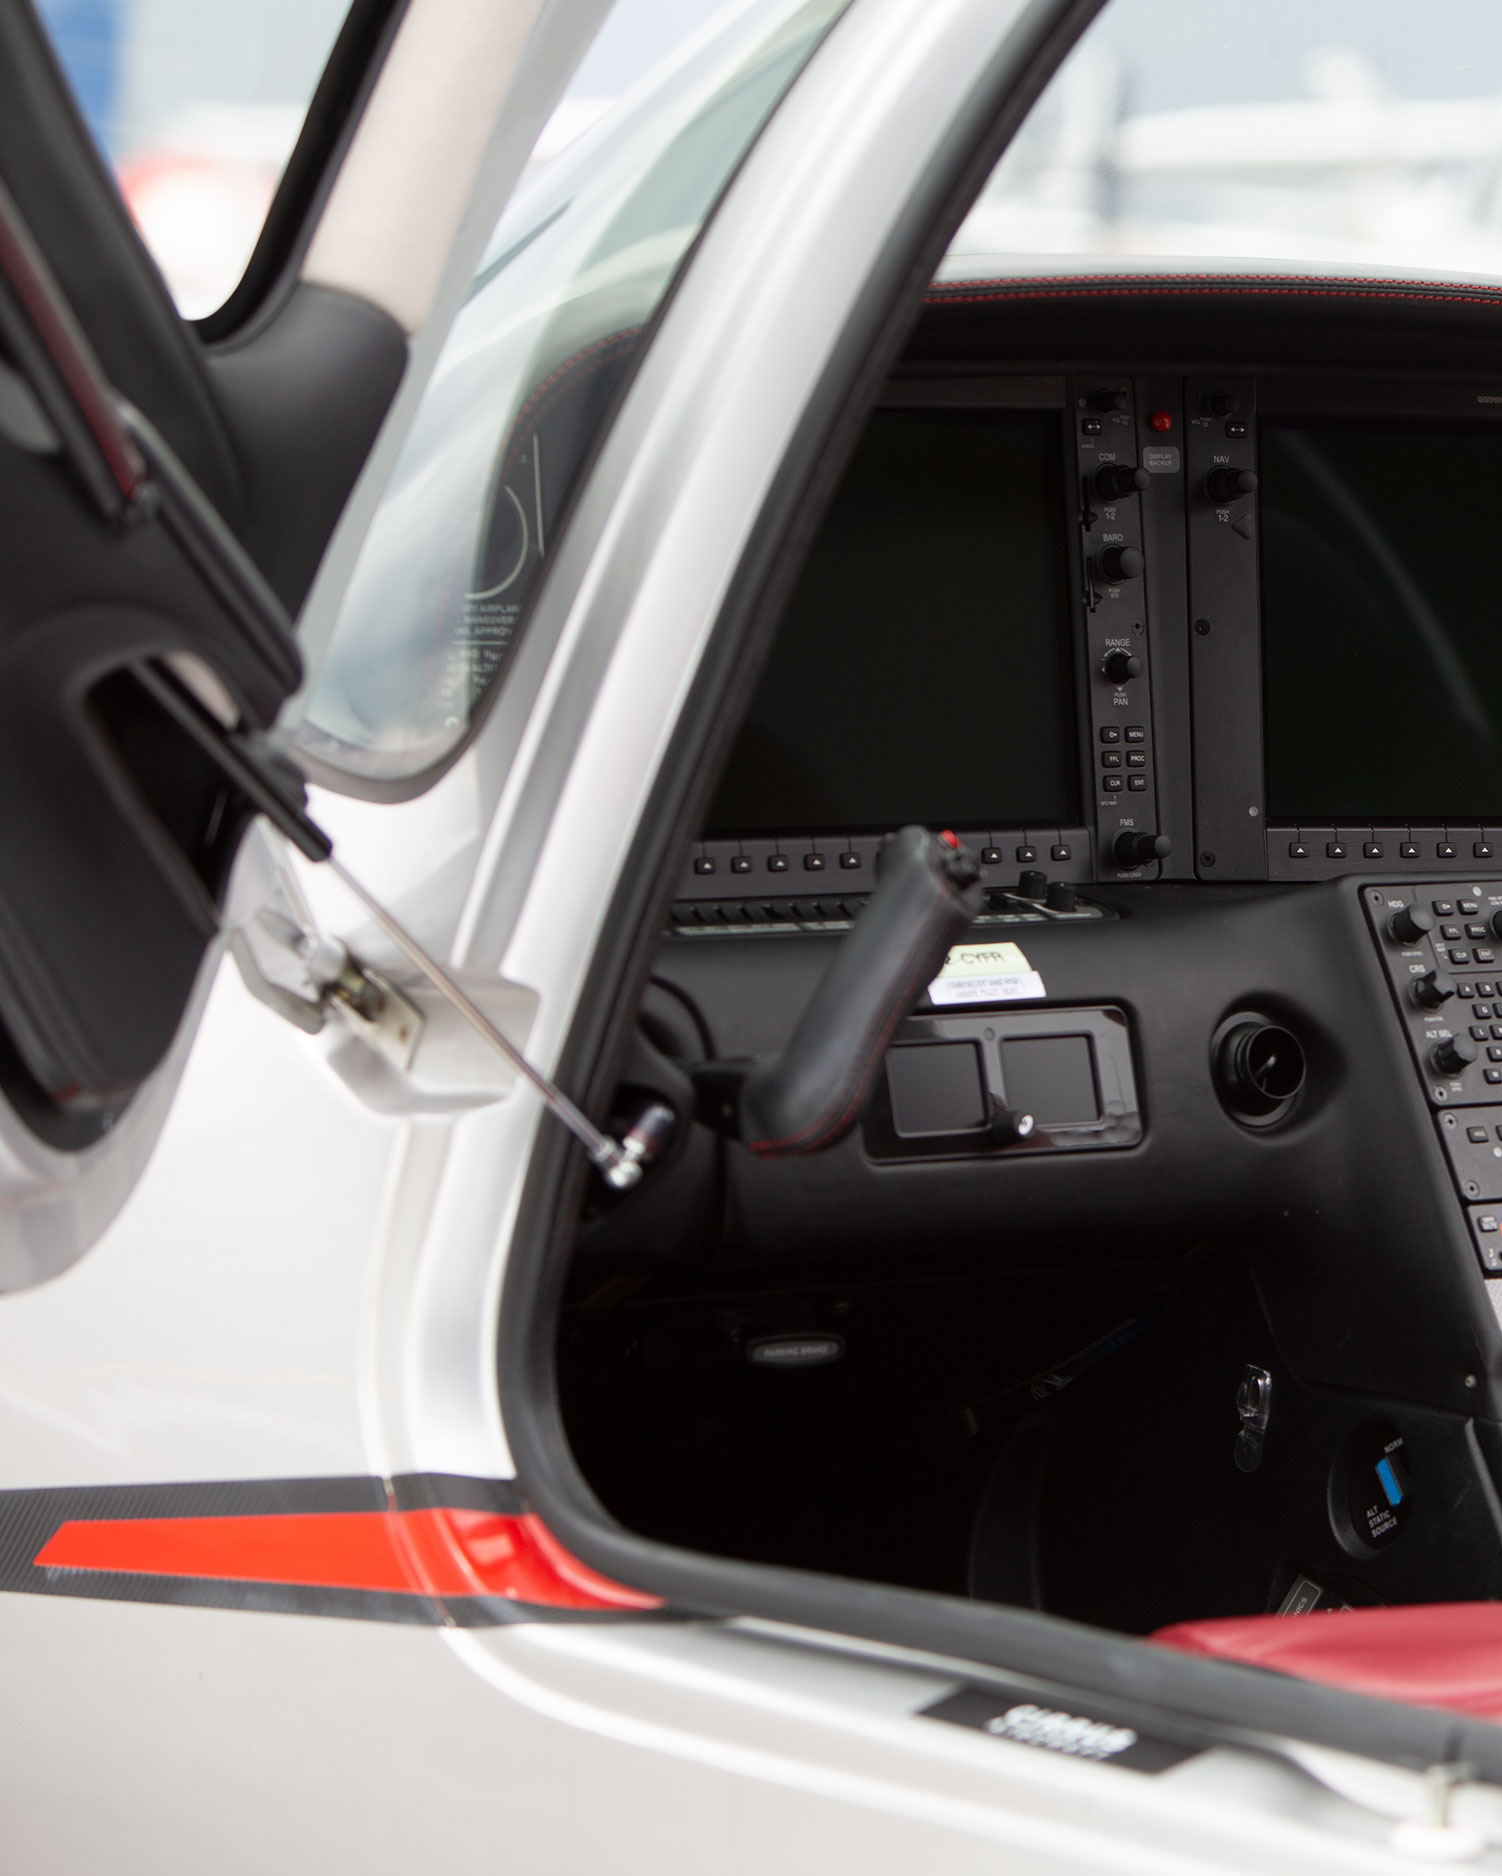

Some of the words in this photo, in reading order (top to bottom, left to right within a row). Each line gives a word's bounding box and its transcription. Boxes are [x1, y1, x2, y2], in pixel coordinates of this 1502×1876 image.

[1098, 453, 1116, 461] COM
[1213, 455, 1230, 463] NAV
[1105, 513, 1116, 521] 1-2
[1103, 533, 1124, 542] BARO
[1105, 639, 1131, 648] RANGE
[1113, 698, 1129, 706] PAN
[1129, 731, 1144, 739] MENU
[1120, 818, 1134, 827] FMS
[1387, 900, 1404, 909] HDG
[1409, 965, 1427, 973] CRS
[1426, 1030, 1437, 1038] ALT
[1438, 1029, 1452, 1037] SEL
[1366, 1505, 1378, 1519] ALT
[1368, 1510, 1391, 1528] STATIC
[1371, 1516, 1399, 1538] SOURCE
